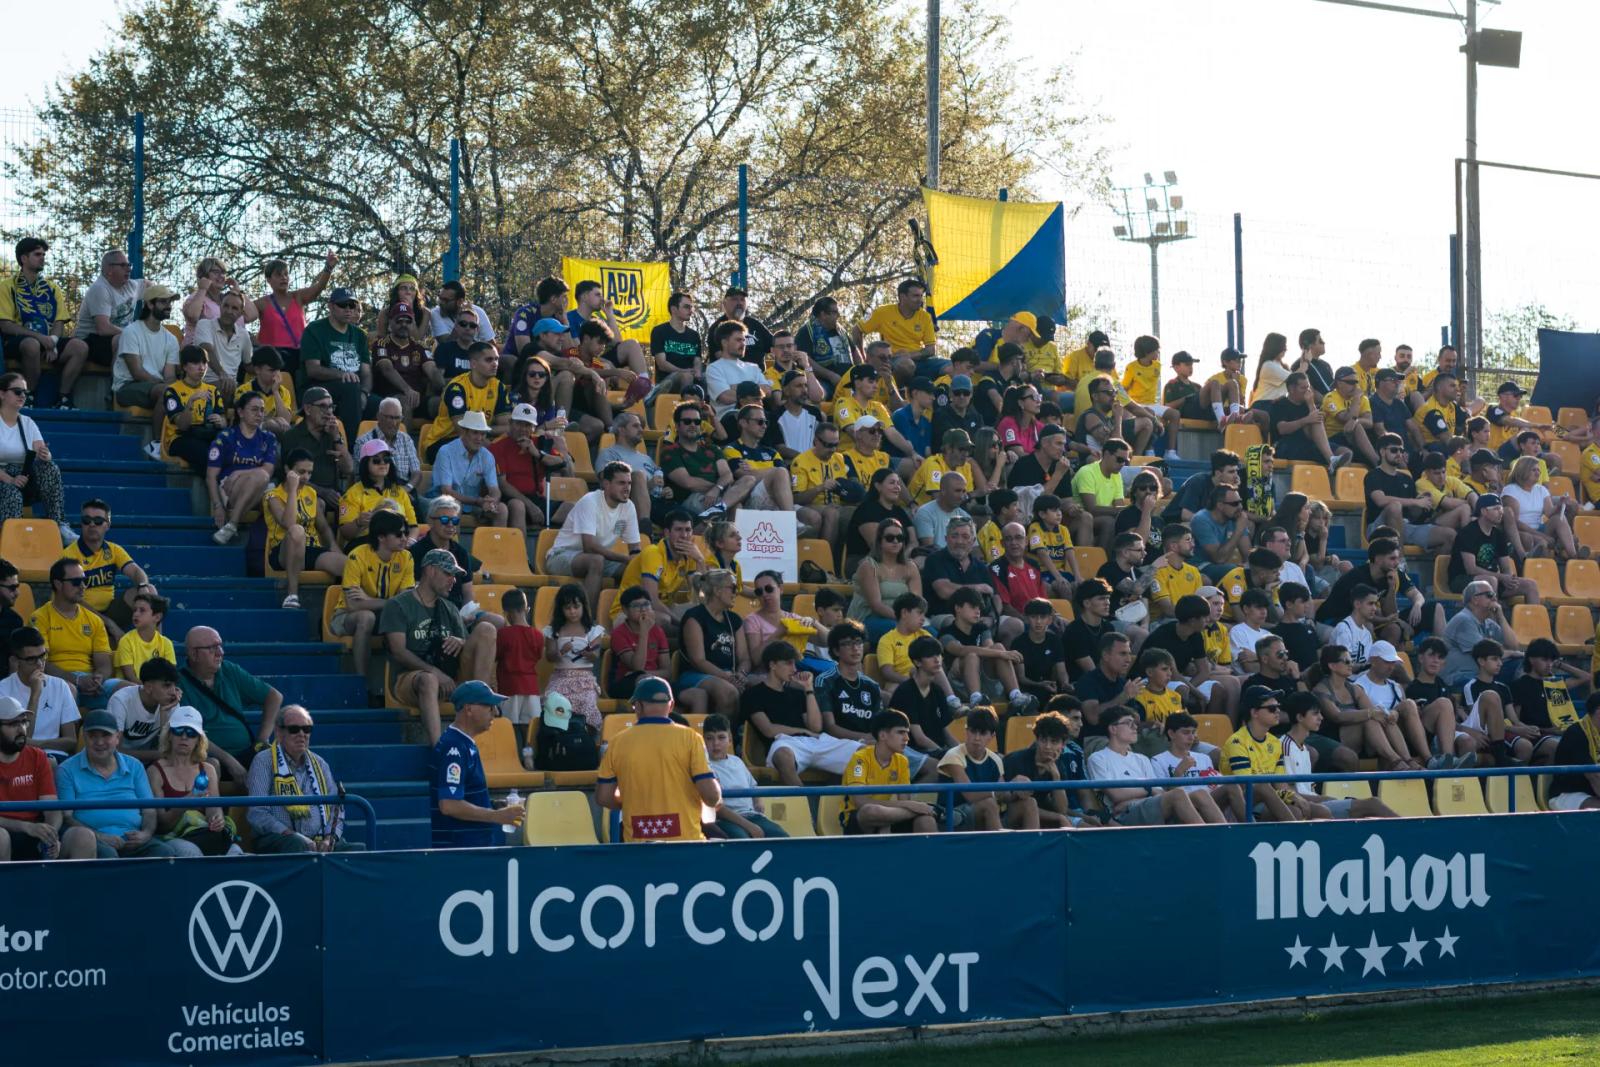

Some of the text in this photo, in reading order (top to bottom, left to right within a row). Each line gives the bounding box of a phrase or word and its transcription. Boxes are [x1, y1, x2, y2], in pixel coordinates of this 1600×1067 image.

[747, 543, 784, 553] Kappa
[1248, 833, 1491, 920] Mahou
[438, 849, 840, 960] alcorcón
[181, 1001, 291, 1027] Vehículos
[167, 1026, 305, 1053] Comerciales
